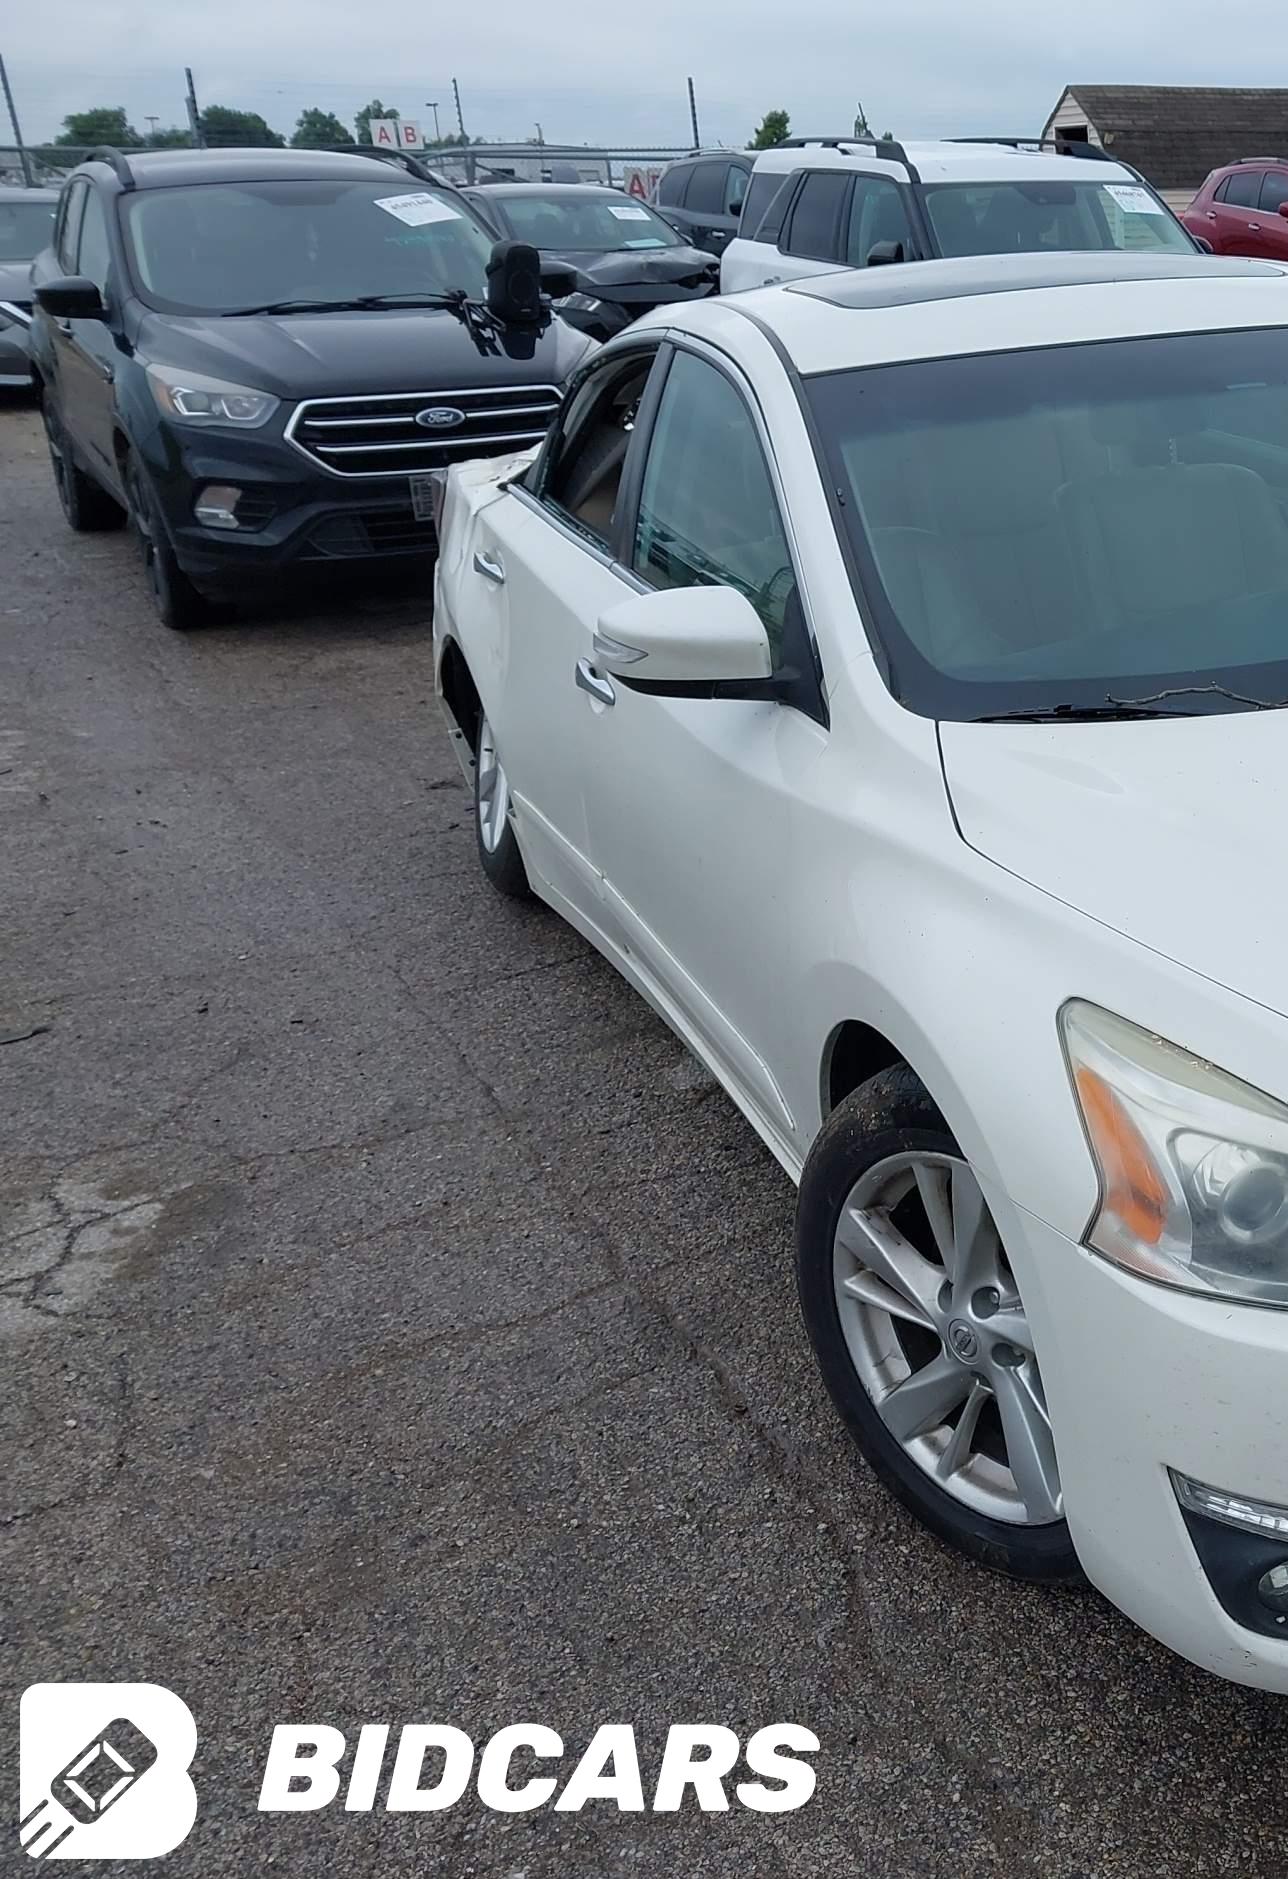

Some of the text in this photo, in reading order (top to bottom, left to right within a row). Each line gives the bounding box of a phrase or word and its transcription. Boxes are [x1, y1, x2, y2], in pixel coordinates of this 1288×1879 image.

[378, 126, 416, 143] A B
[630, 174, 646, 199] A
